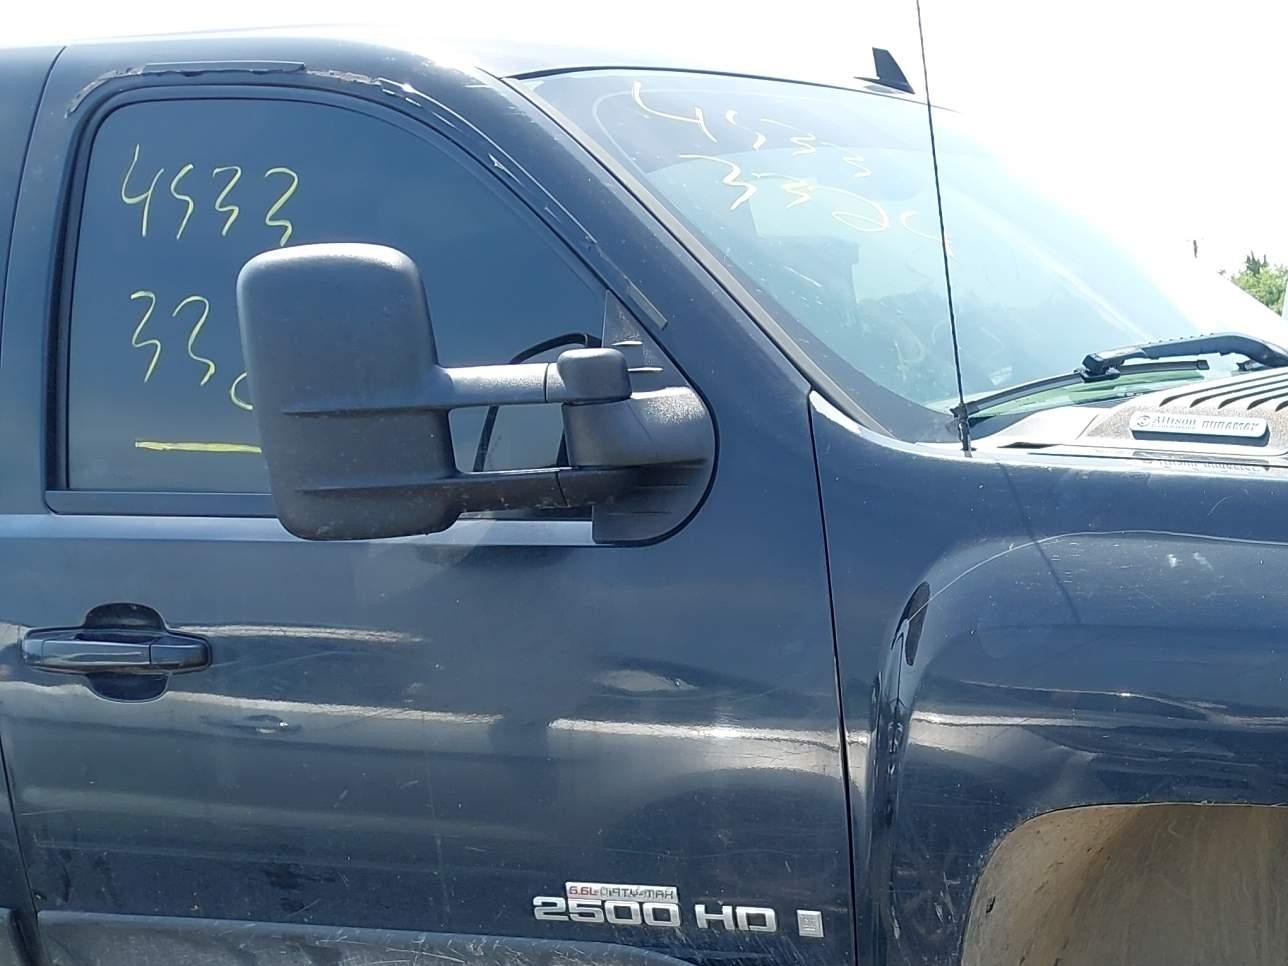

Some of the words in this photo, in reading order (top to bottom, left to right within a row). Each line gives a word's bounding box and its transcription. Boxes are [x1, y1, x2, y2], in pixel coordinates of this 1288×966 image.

[120, 143, 300, 248] 4533
[532, 895, 681, 927] 2500
[694, 904, 777, 933] HD
